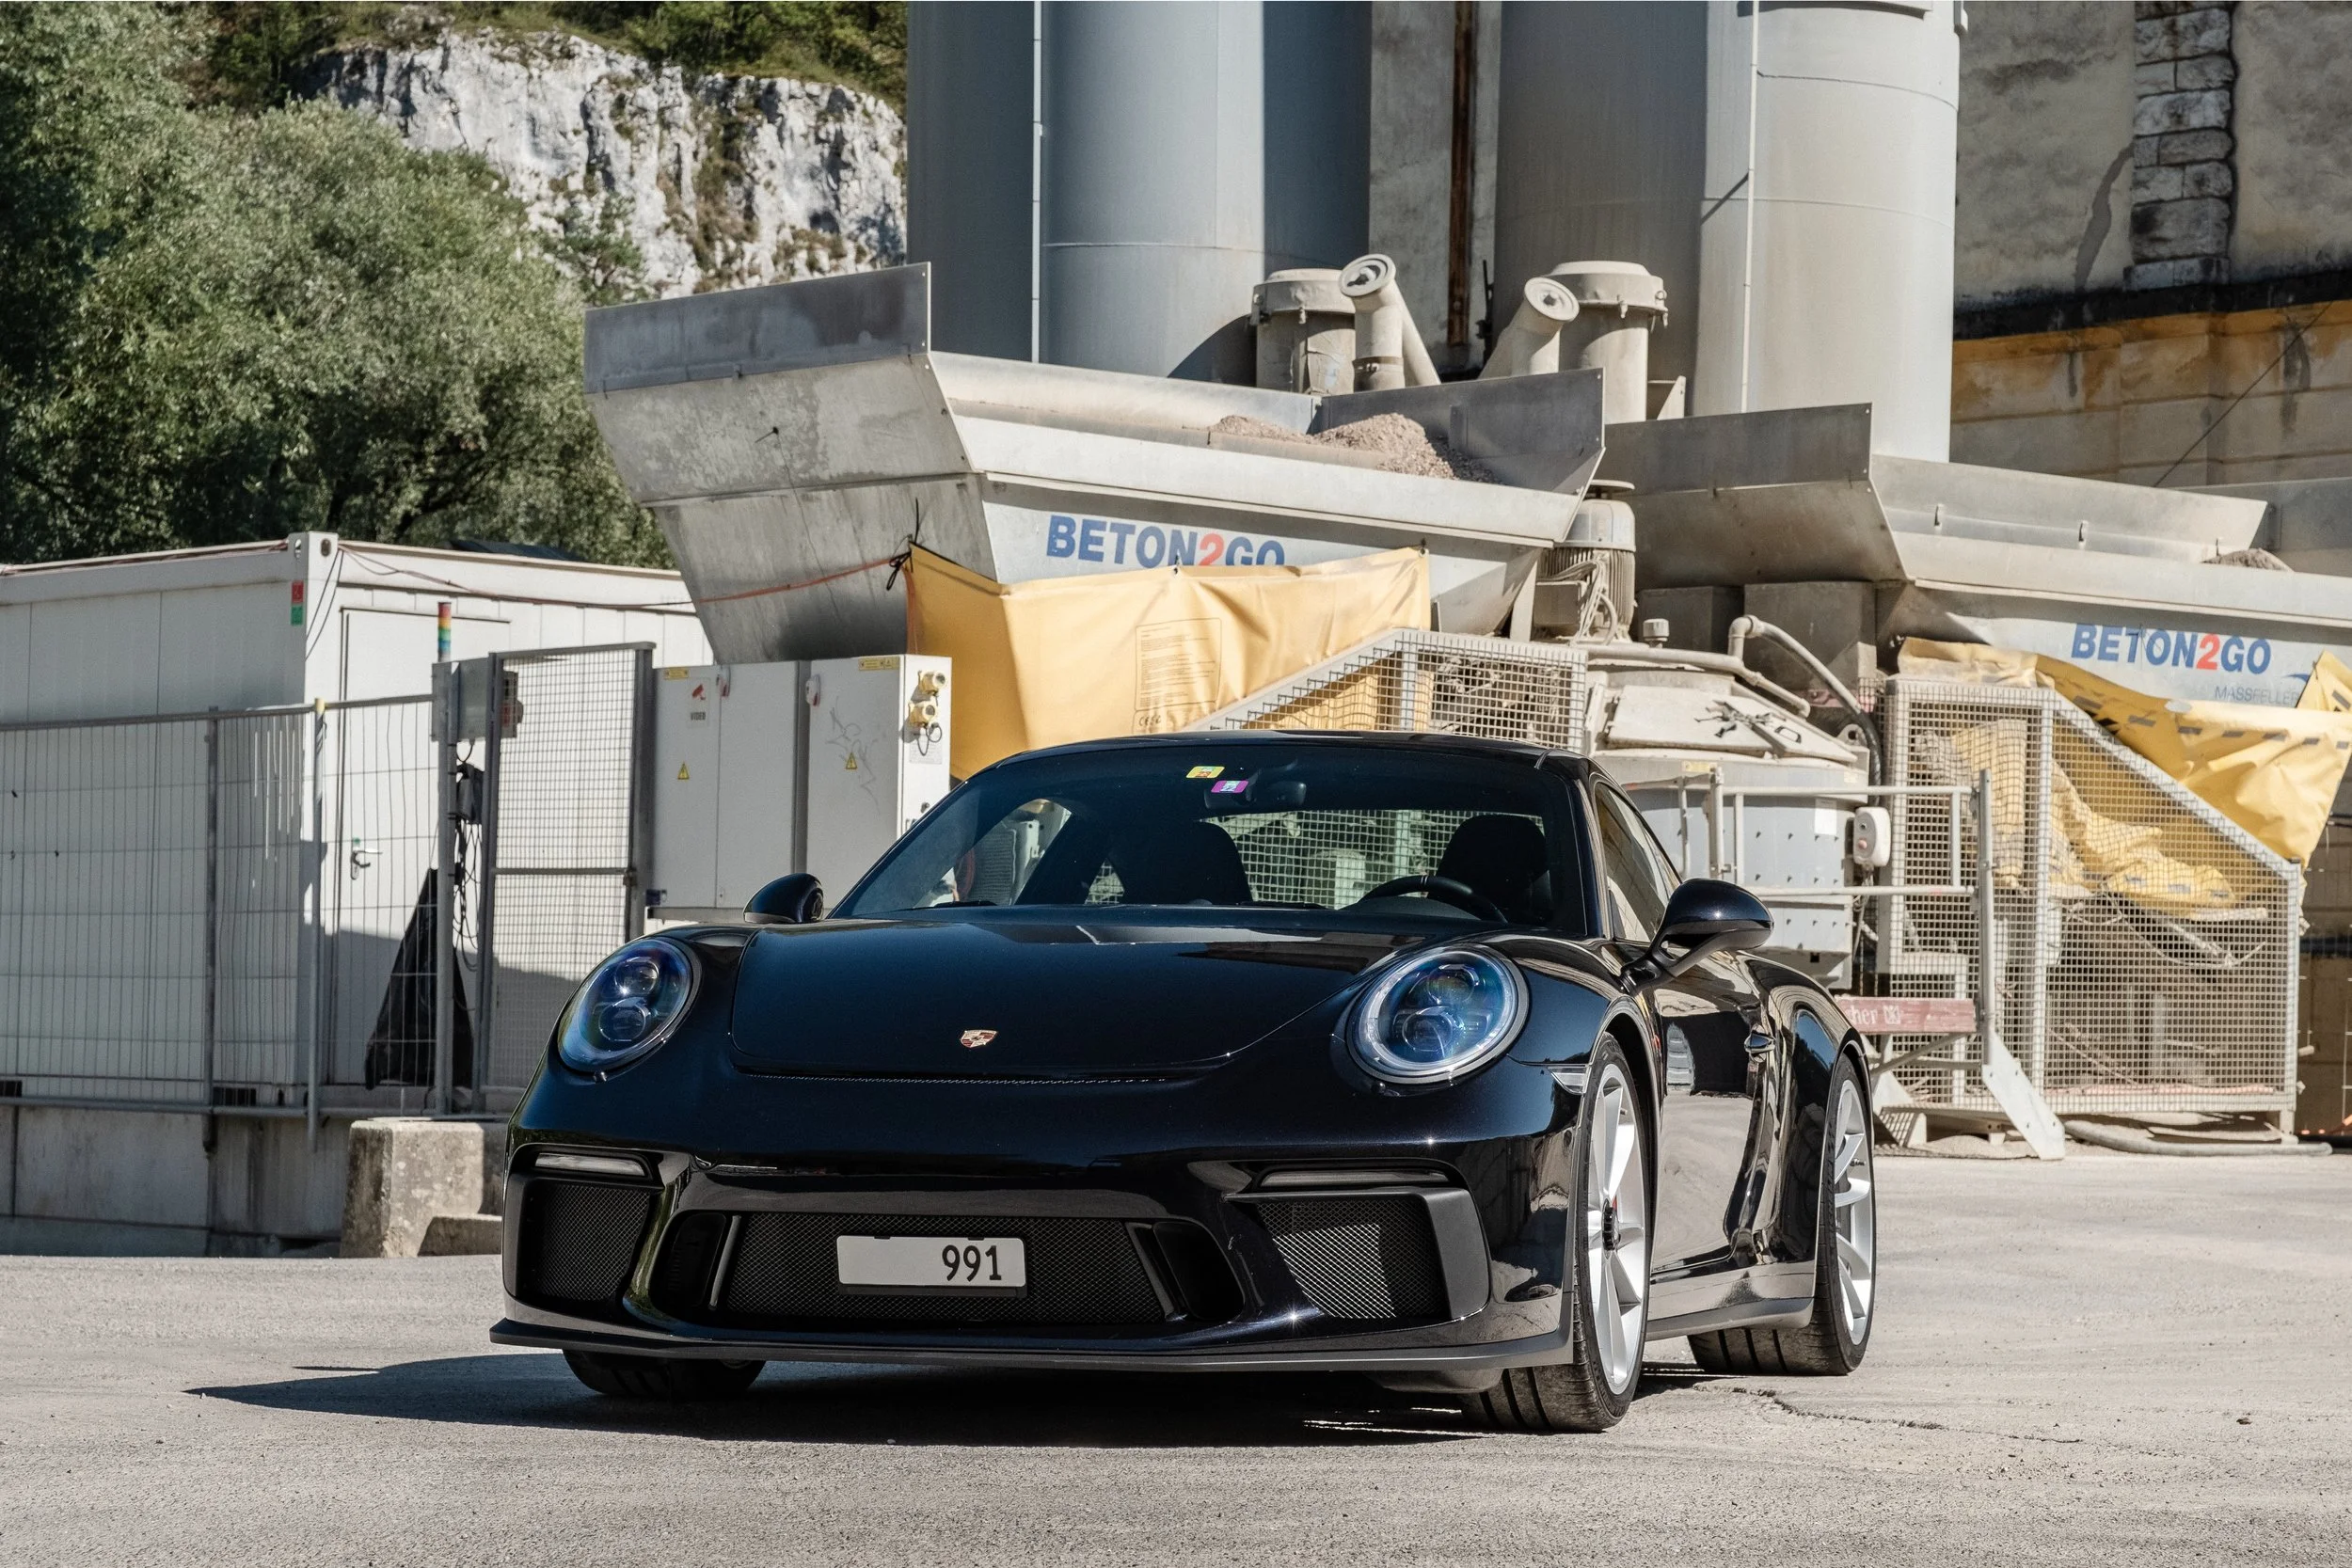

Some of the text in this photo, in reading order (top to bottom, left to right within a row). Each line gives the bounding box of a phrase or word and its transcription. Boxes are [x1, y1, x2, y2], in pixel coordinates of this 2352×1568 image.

[1046, 515, 1285, 566] BETON2GO
[2071, 624, 2271, 674] BETON2GO
[1846, 1005, 1878, 1025] cher
[942, 1244, 1002, 1282] 991
